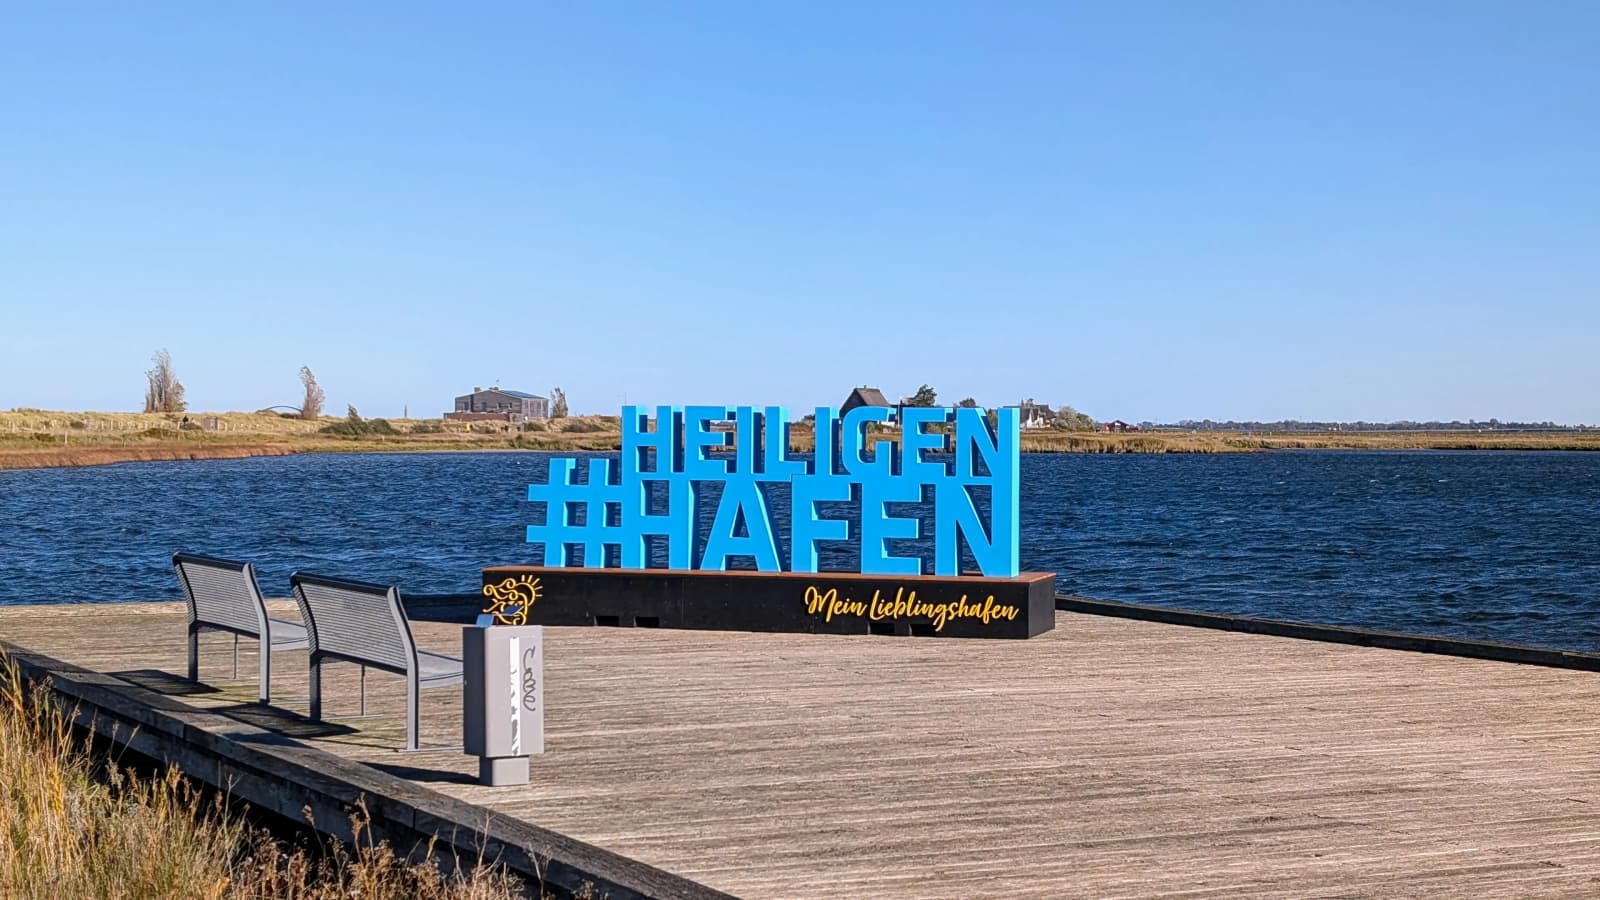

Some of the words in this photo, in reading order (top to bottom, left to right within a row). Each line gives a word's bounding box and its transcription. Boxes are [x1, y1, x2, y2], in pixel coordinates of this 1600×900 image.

[621, 405, 1020, 479] HEILIGEN
[526, 457, 1020, 578] #HAFEN
[804, 586, 867, 622] Mein
[869, 586, 1019, 632] Lieblingshafen
